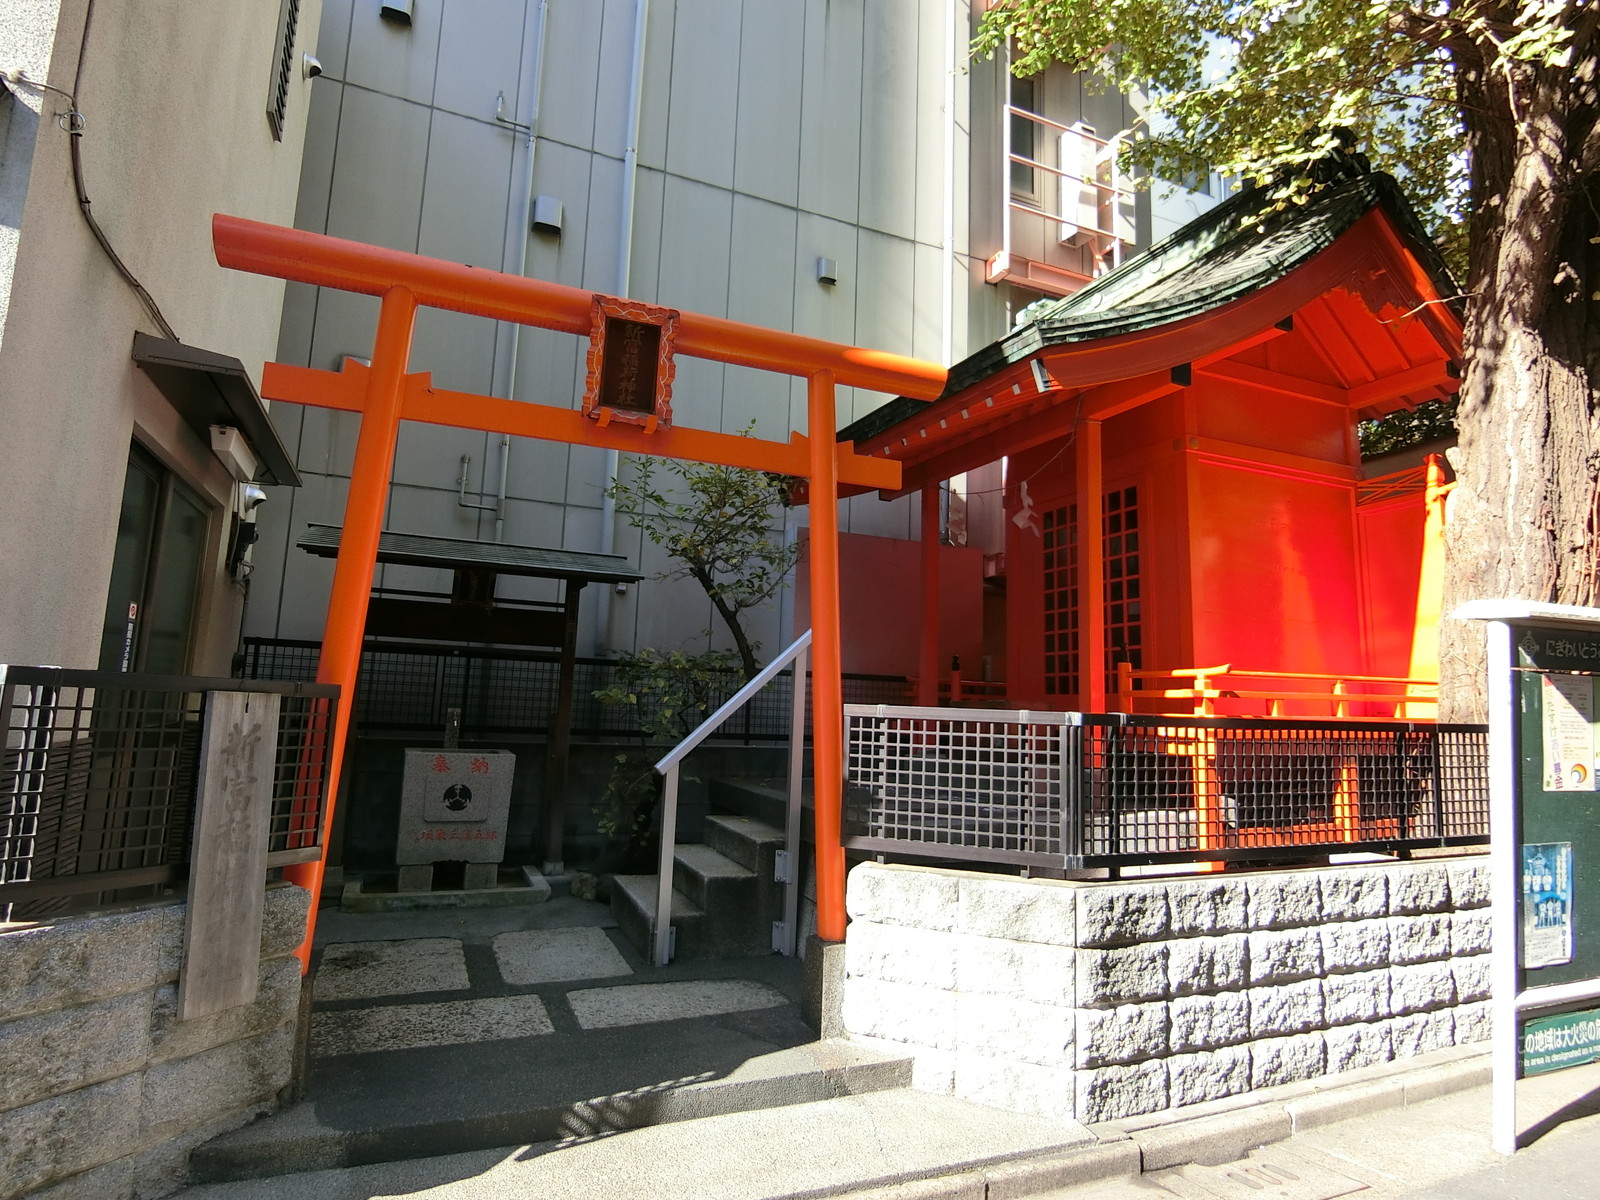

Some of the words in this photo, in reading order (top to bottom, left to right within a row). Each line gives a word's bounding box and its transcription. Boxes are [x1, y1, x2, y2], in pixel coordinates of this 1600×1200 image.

[1545, 639, 1600, 659] にぎわいとう
